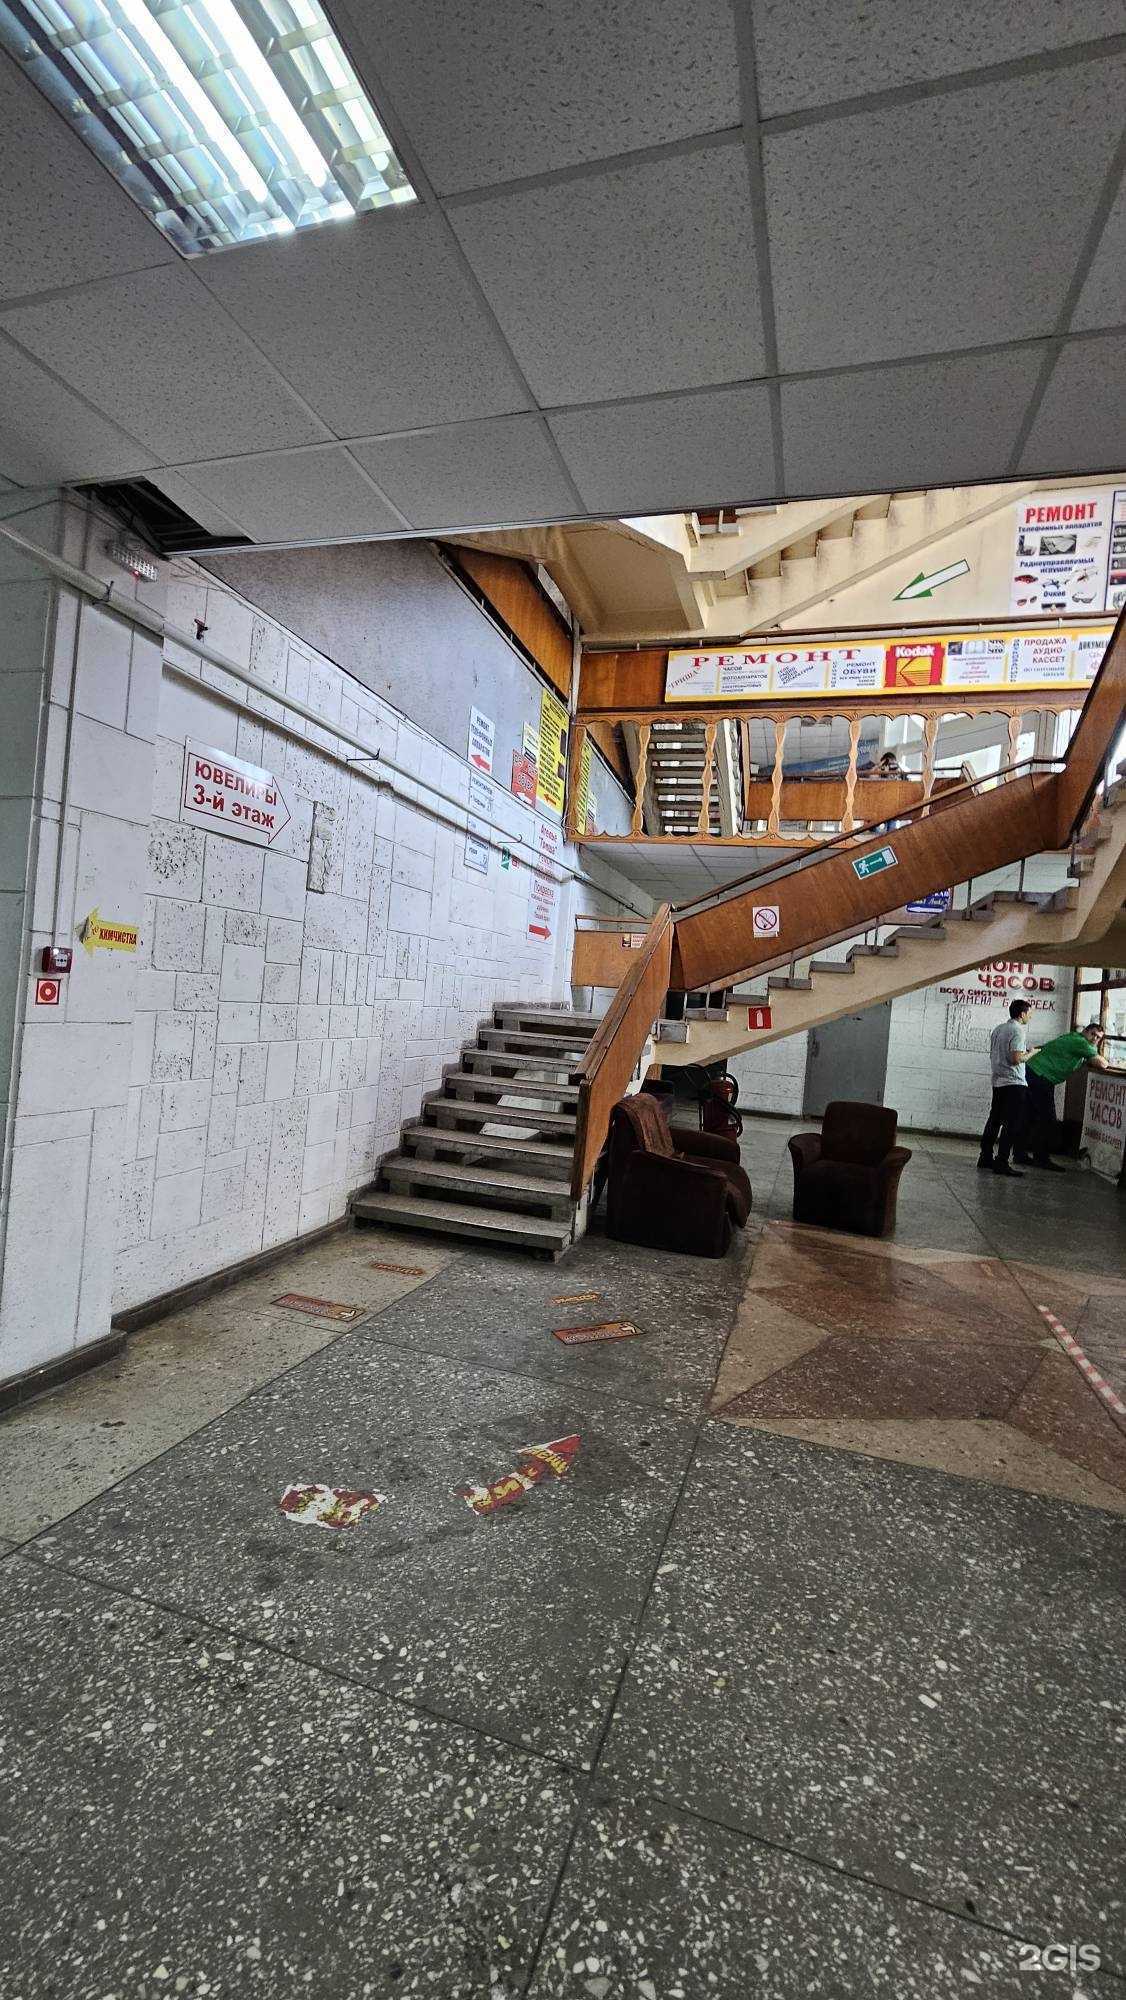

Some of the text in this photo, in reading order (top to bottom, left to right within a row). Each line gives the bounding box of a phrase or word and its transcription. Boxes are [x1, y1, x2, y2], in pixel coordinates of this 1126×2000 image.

[1025, 502, 1098, 524] РЕМОНТ
[1018, 525, 1064, 533] Телефонных
[1024, 638, 1067, 646] ПРОДАЖА
[691, 649, 861, 667] РЕМОНТ
[895, 645, 935, 657] Kodak
[1032, 656, 1065, 664] КАССЕТ
[193, 784, 275, 829] 3-й этаж
[99, 927, 137, 945] ХИМЧИСТКА
[939, 987, 1008, 997] всех систем
[951, 994, 1056, 1011] ЗАМЕНА БРЕЕК
[1089, 1079, 1126, 1106] РЕМОНТ
[1089, 1101, 1122, 1129] ЧАСОВ
